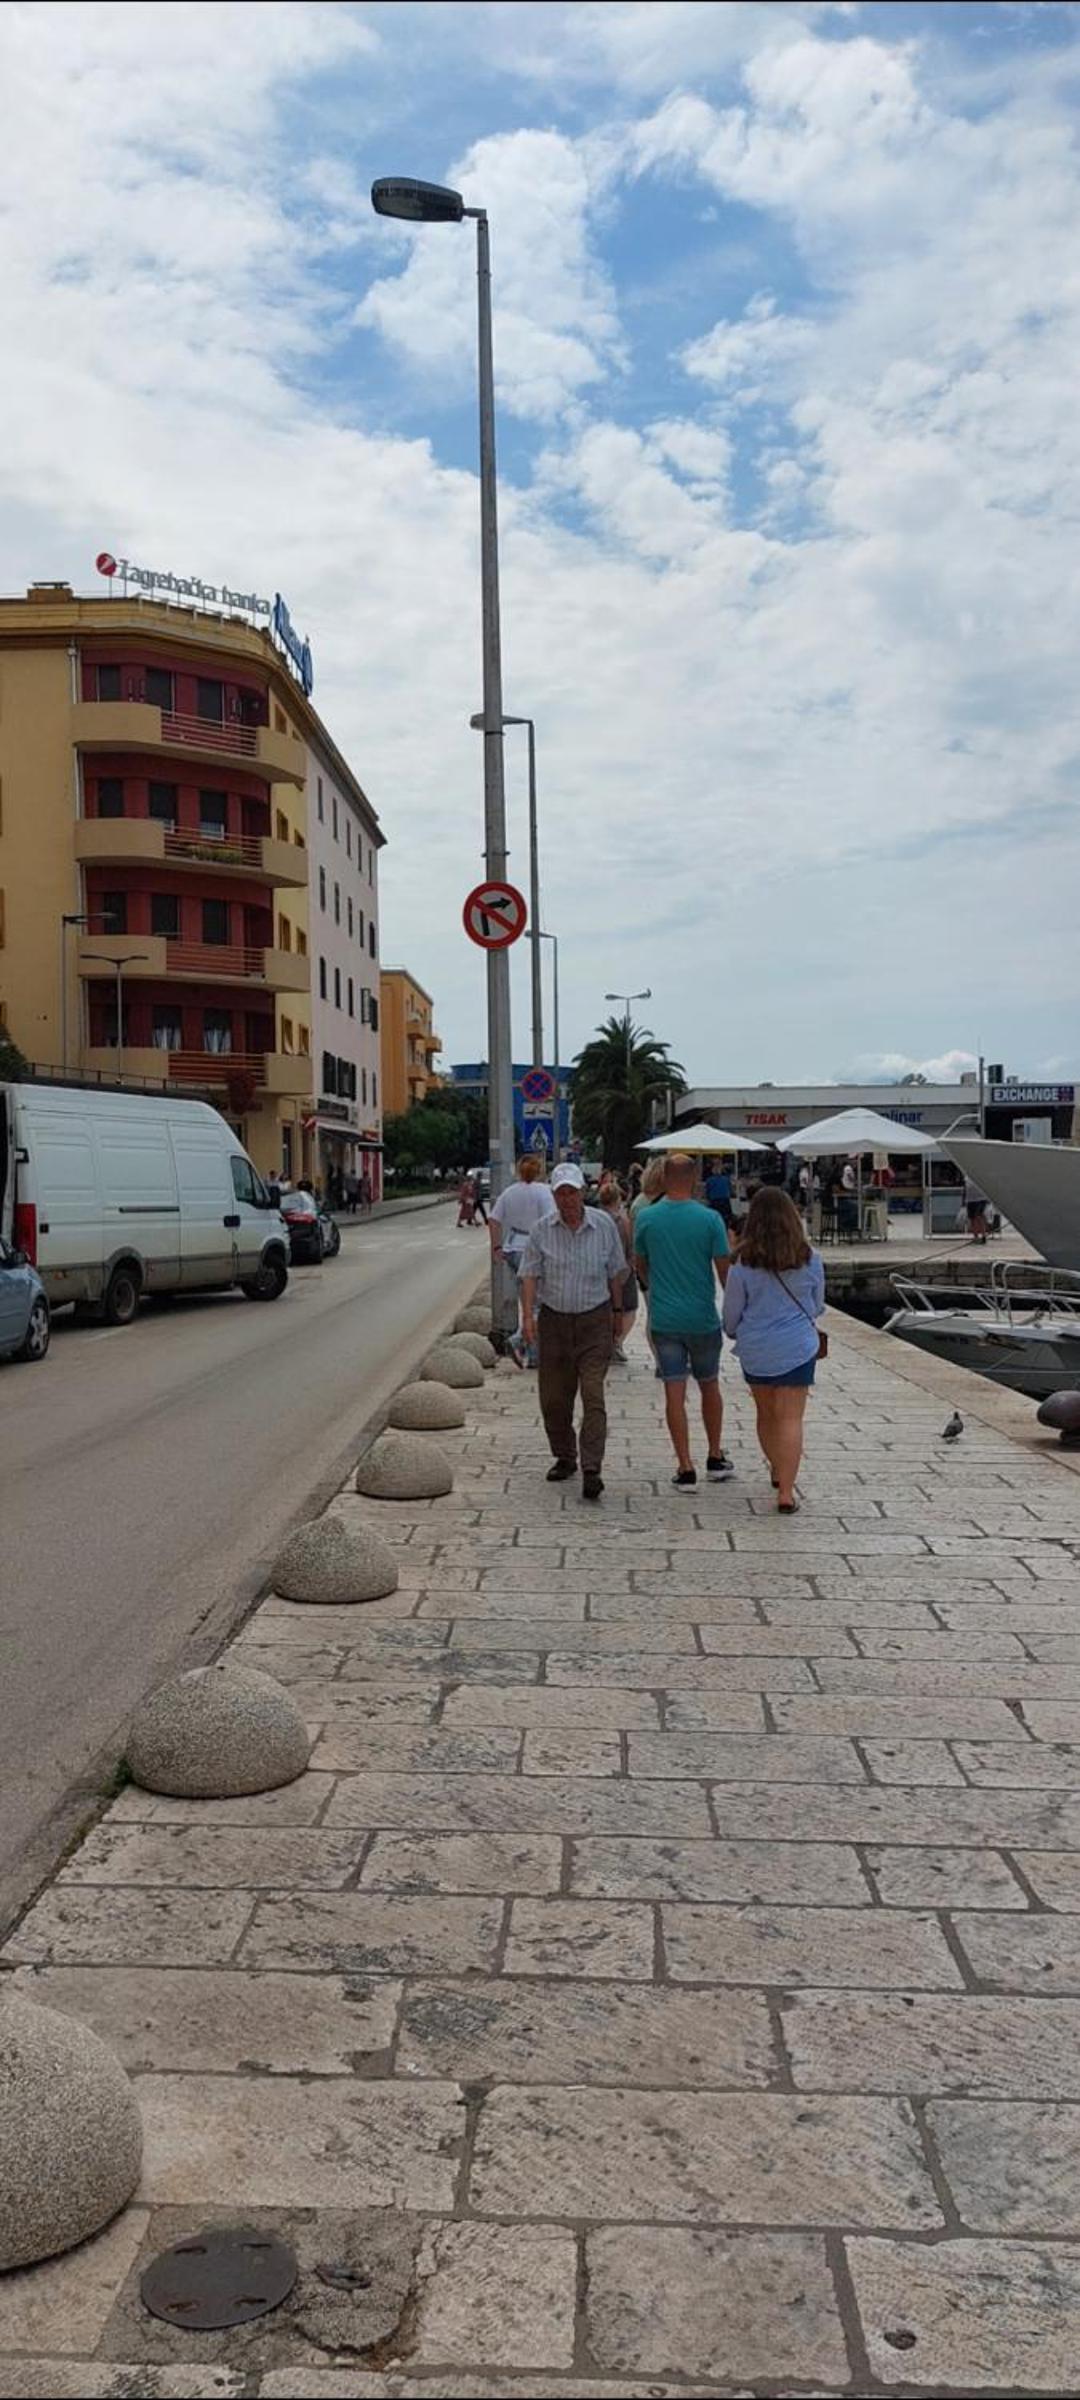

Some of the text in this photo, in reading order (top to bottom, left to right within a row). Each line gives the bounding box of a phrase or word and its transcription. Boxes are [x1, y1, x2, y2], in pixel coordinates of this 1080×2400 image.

[223, 585, 271, 614] banka
[993, 1087, 1060, 1102] EXCHANGE
[744, 1112, 787, 1125] TISAK
